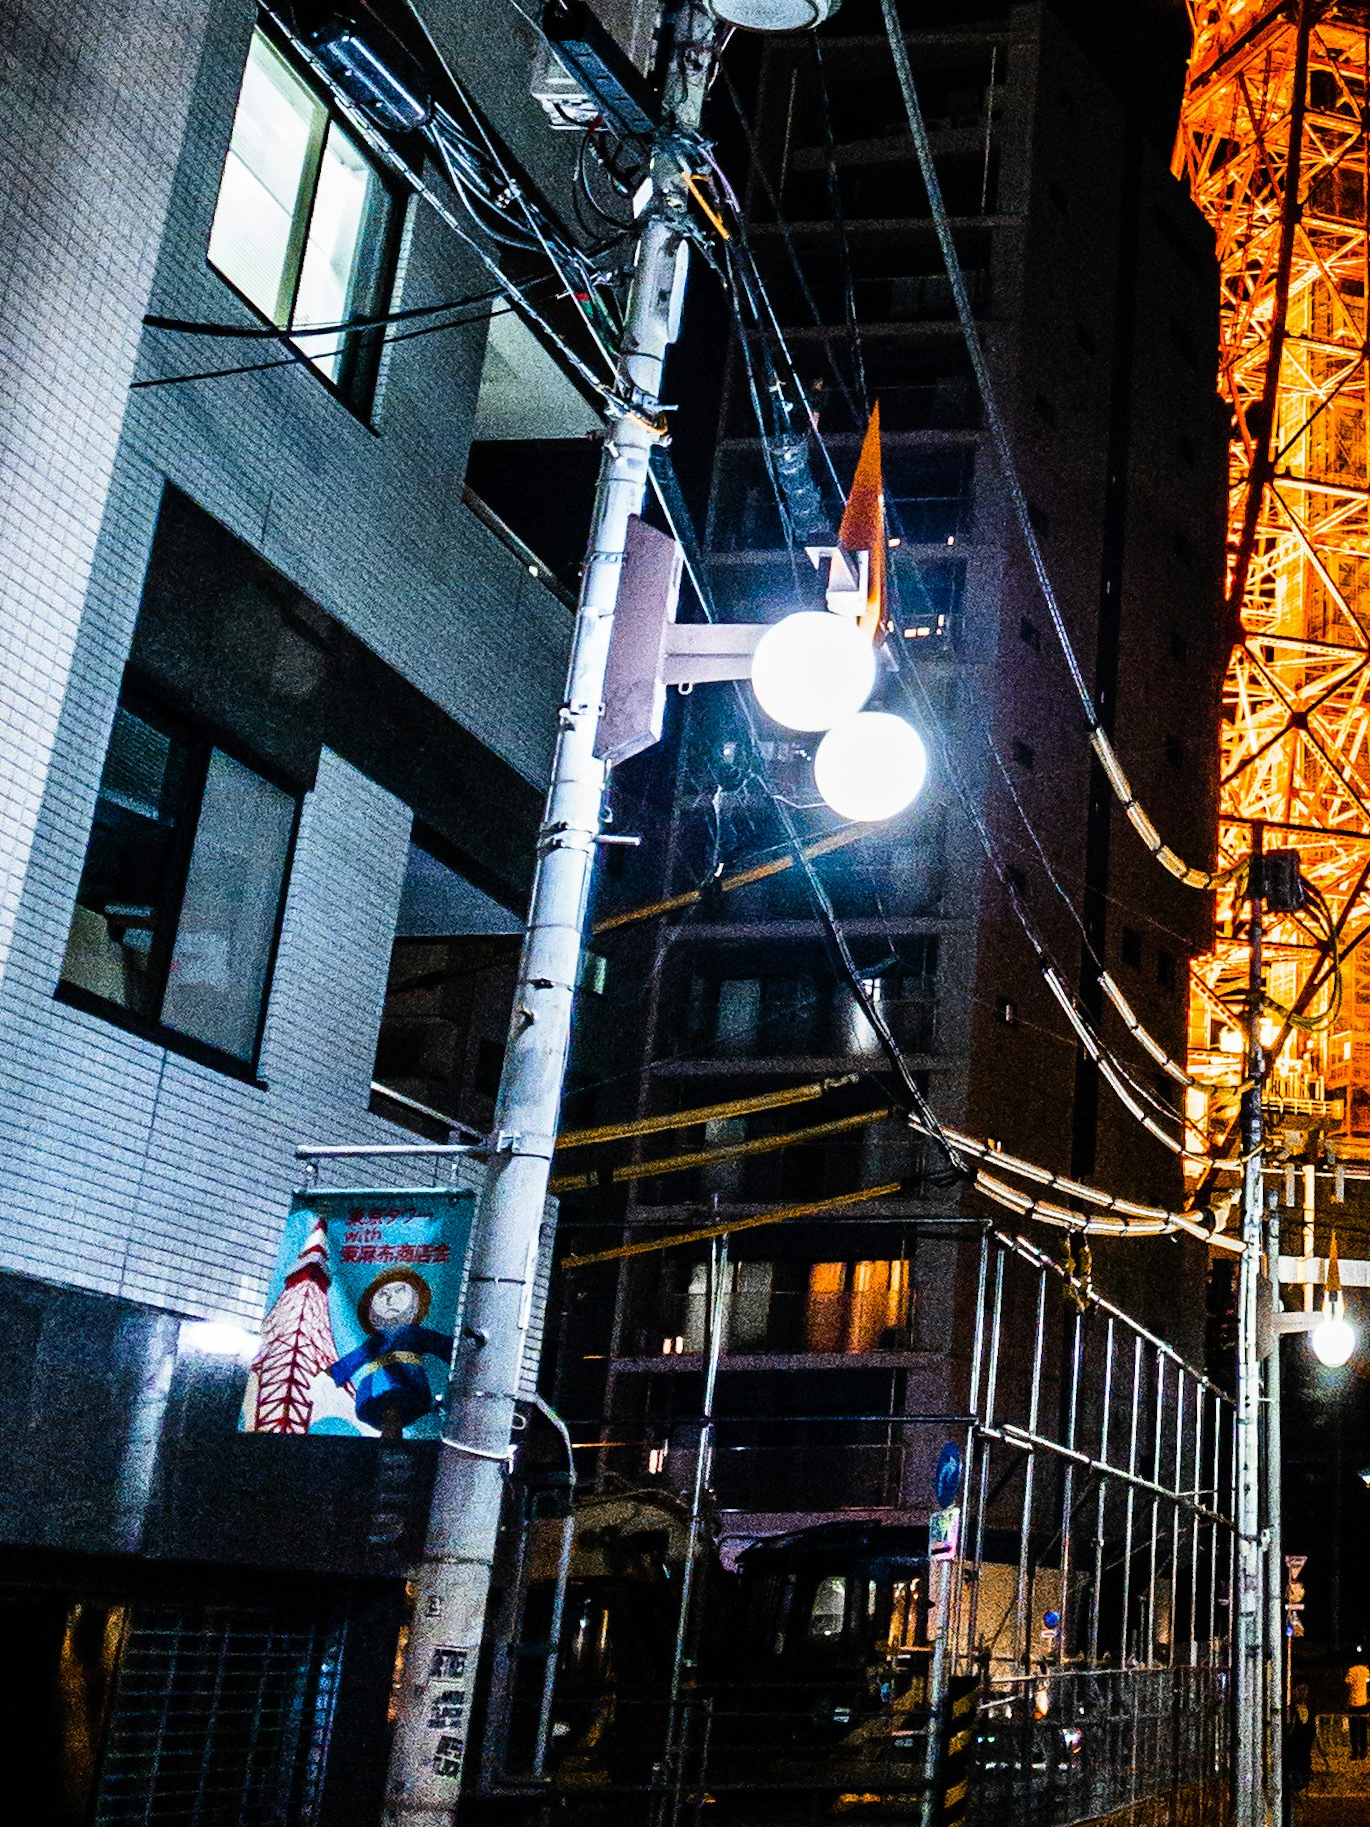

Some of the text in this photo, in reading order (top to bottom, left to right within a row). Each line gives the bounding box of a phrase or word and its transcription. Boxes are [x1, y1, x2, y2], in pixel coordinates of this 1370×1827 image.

[347, 1207, 434, 1226] 東京タワー
[344, 1228, 382, 1242] with
[341, 1244, 450, 1263] 東麻布商店会
